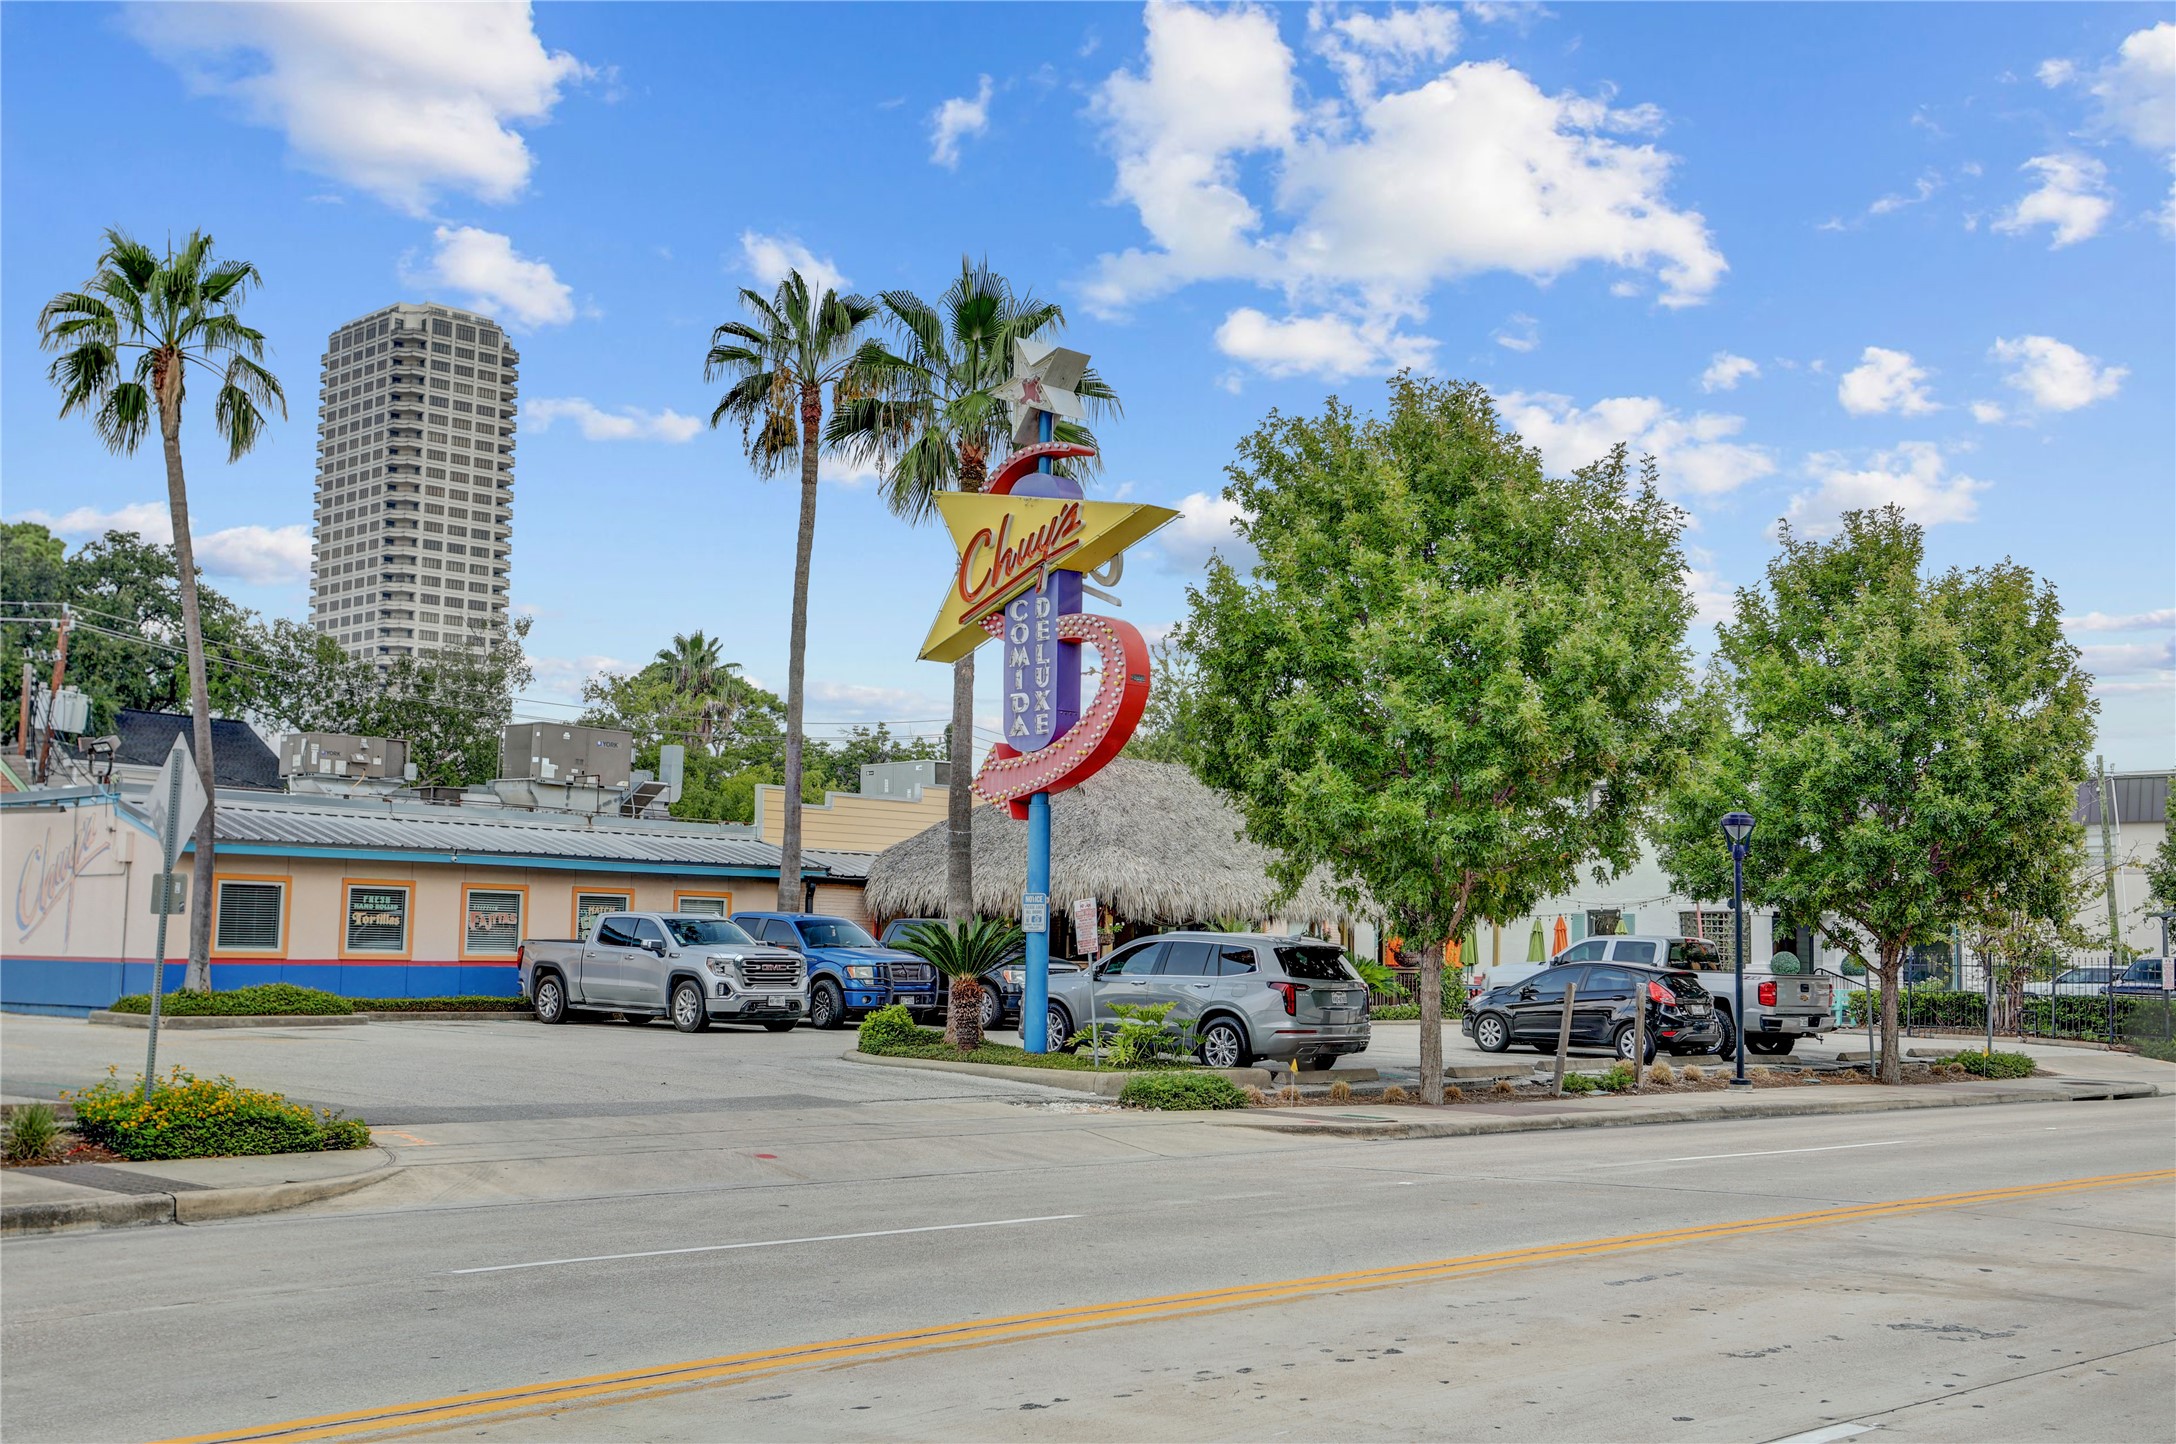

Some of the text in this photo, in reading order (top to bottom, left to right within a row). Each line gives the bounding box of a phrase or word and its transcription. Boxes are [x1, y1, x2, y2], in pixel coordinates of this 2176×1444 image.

[958, 501, 1085, 604] Chuy's
[1009, 599, 1031, 737] COMIDA
[1034, 596, 1052, 735] DELUXE
[363, 895, 391, 904] FRESH
[1025, 895, 1044, 903] NOTICE
[351, 911, 401, 926] Tortillas
[469, 911, 519, 930] FAJITAS
